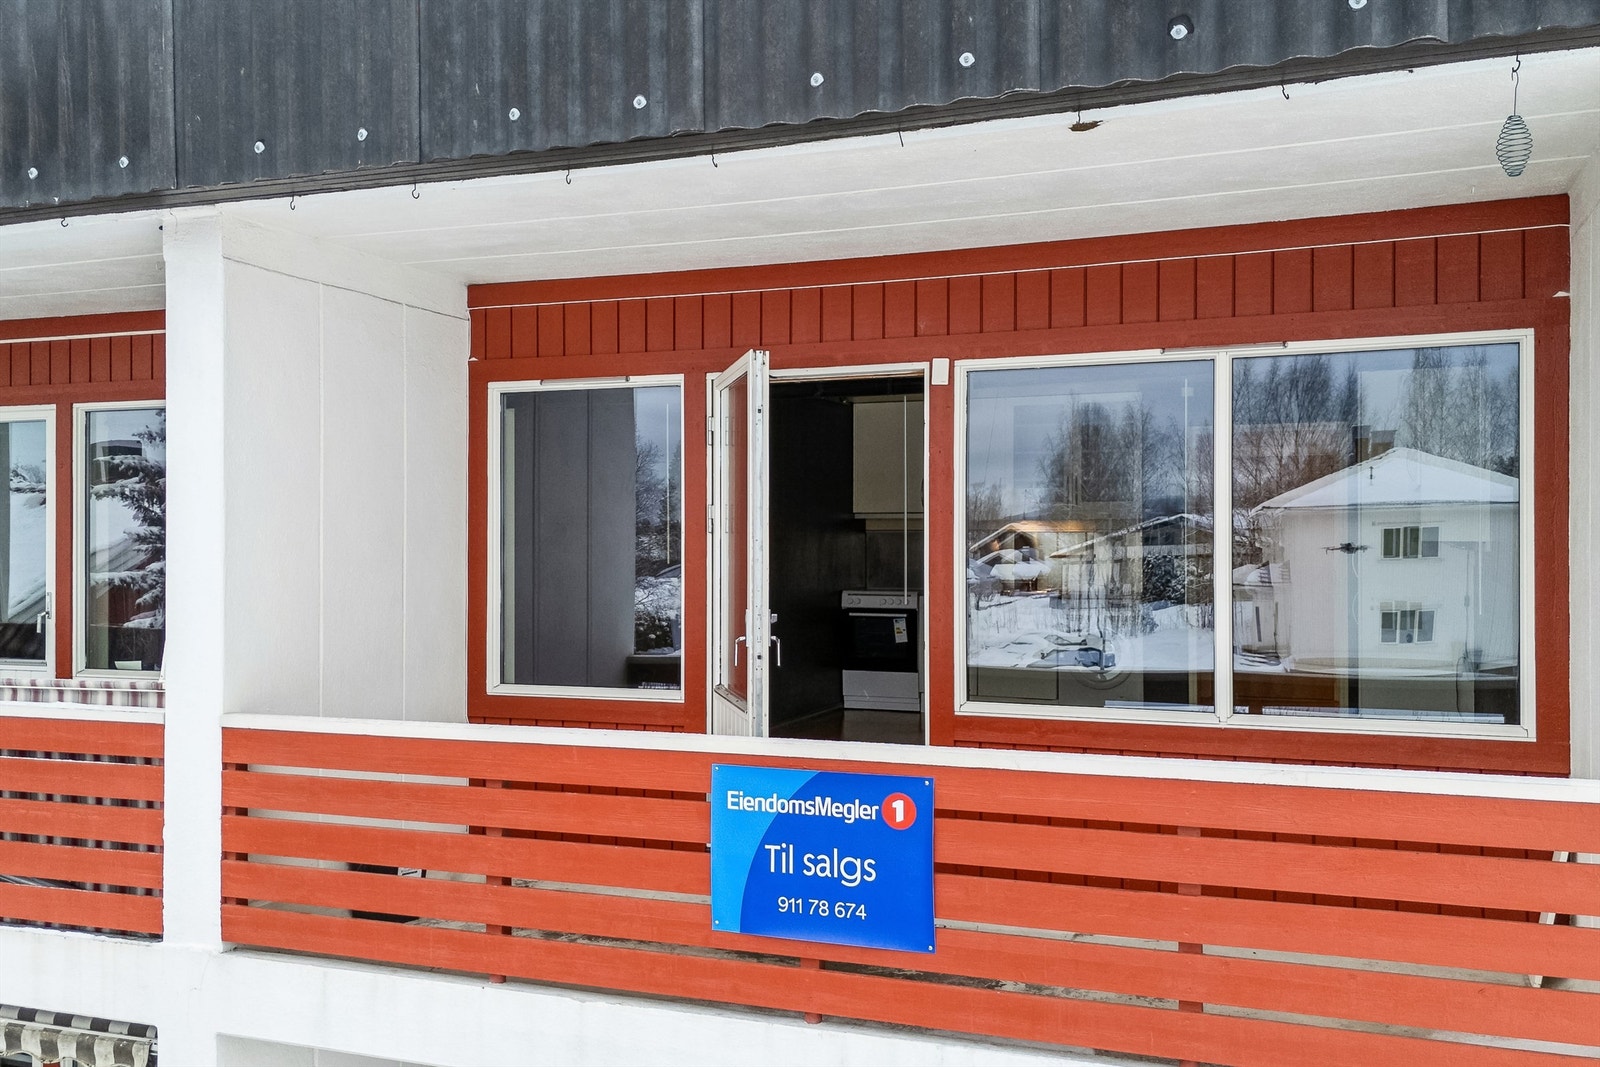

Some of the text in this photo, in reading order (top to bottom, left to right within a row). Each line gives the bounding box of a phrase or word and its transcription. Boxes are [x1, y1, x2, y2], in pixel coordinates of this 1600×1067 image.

[726, 790, 879, 824] EiendomsMegler
[764, 843, 877, 887] Til salgs
[778, 896, 867, 920] 911 78 674
